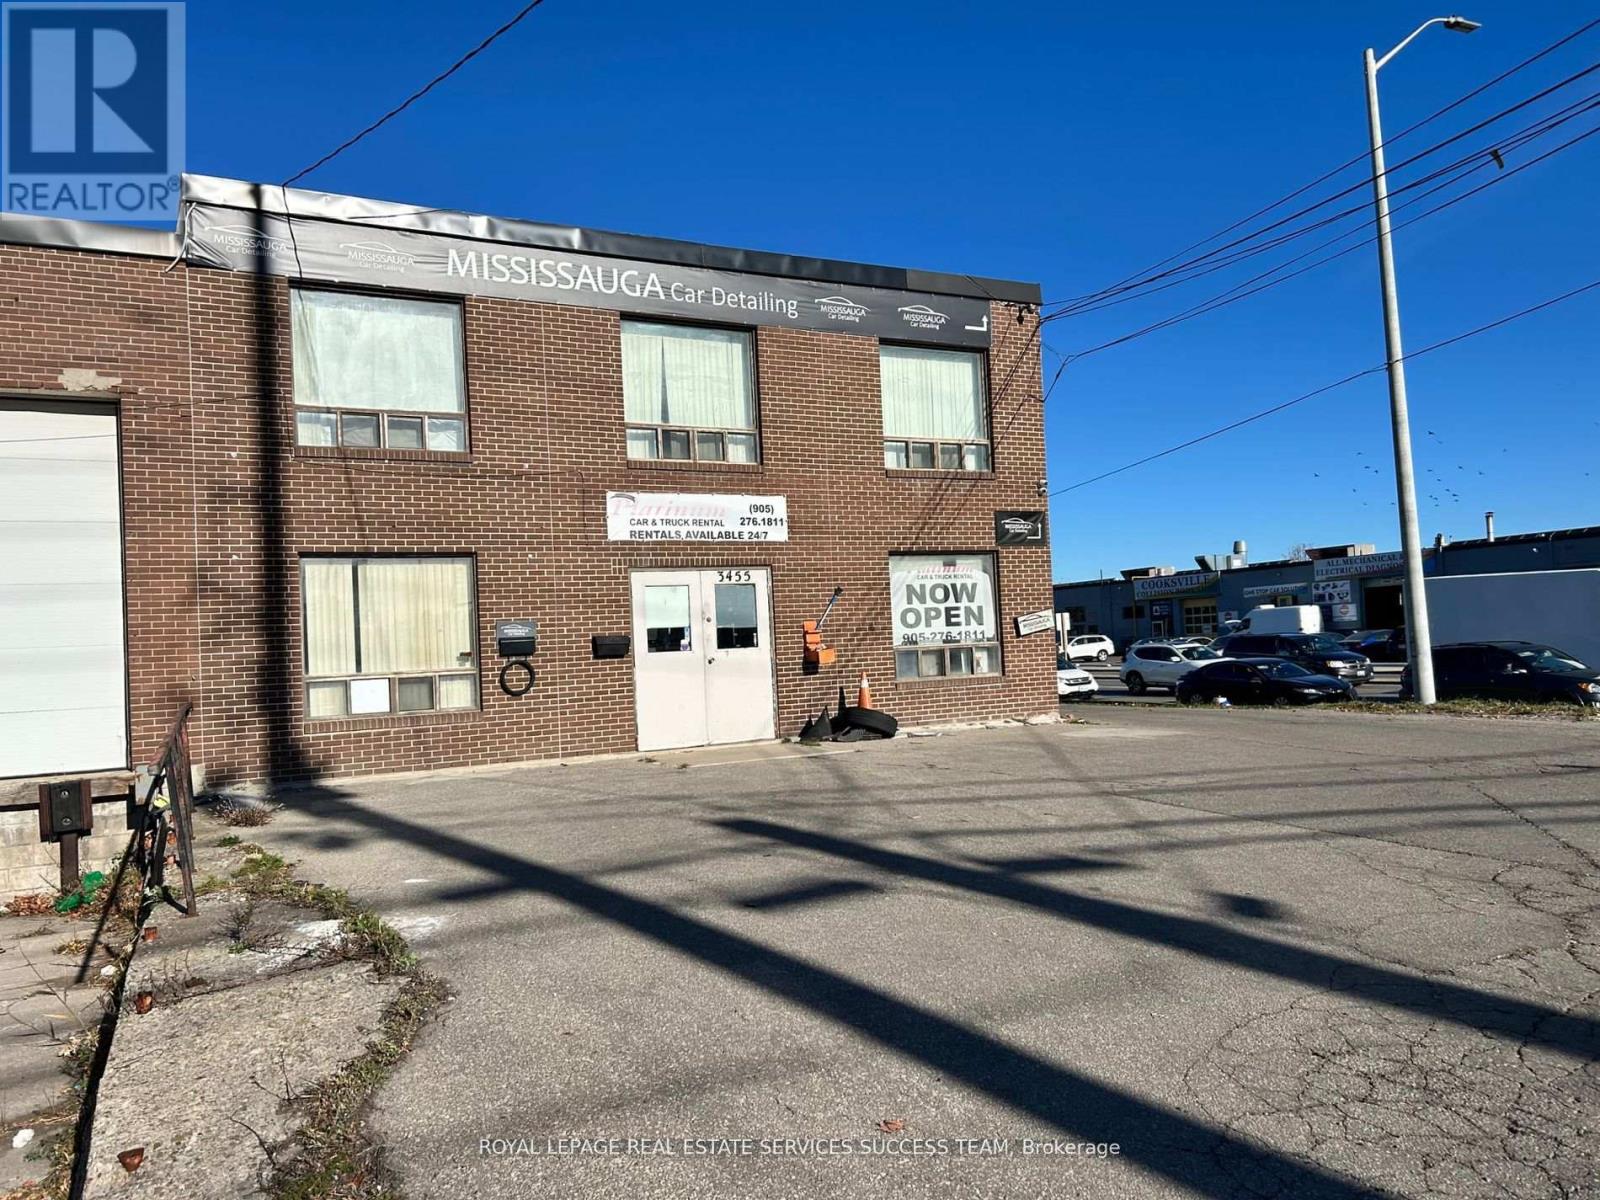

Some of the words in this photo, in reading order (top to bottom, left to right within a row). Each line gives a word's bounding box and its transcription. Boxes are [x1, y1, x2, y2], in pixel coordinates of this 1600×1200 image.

[213, 234, 287, 252] MISSISSAUGA
[347, 249, 415, 265] MISSISSAUGA
[447, 248, 665, 300] MISSISSAUGA
[670, 281, 704, 304] Car
[712, 286, 798, 319] Detailing
[820, 304, 866, 317] MISSISSAUGA
[828, 312, 836, 320] Car
[837, 313, 860, 323] Detailing
[902, 312, 946, 325] MISSISSAUGA
[909, 320, 918, 328] Car
[918, 321, 940, 331] Detailing
[749, 504, 774, 515] (905)
[629, 518, 648, 527] CAR
[651, 518, 657, 527] &
[660, 518, 690, 527] TRUCK
[692, 518, 725, 528] RENTAL
[739, 516, 784, 527] 276.1811
[685, 531, 744, 541] AVAILABLE
[747, 531, 768, 540] 24/7
[716, 570, 751, 582] 3455
[905, 582, 978, 605] NOW
[900, 605, 984, 629] OPEN
[902, 630, 986, 642] 905-276-1811
